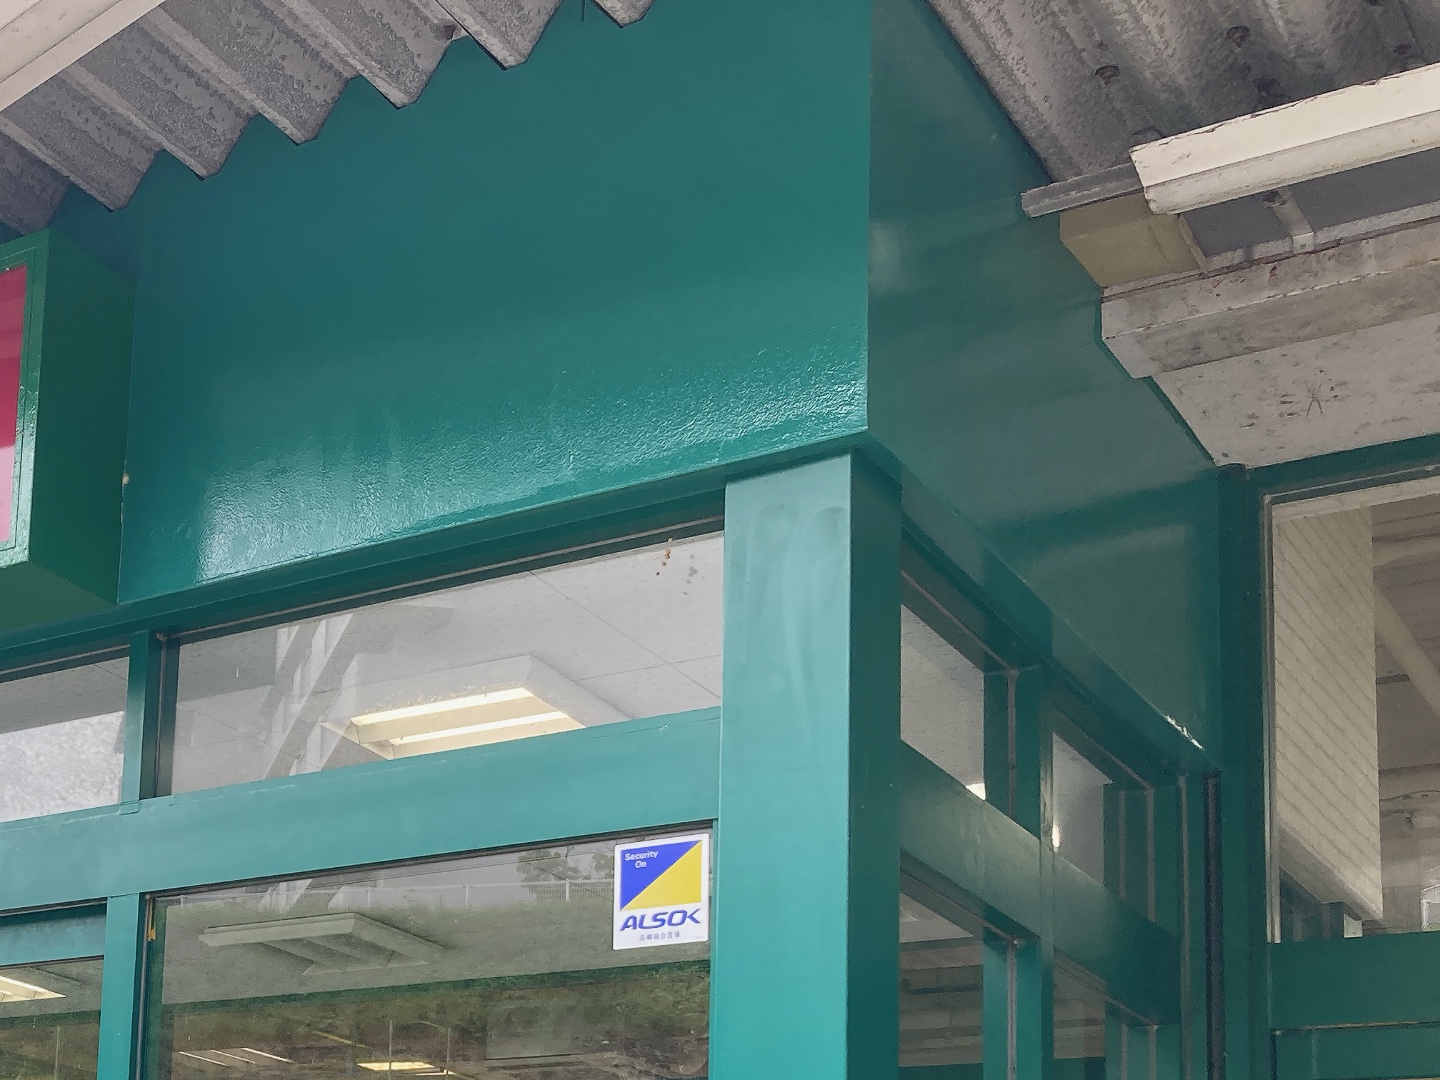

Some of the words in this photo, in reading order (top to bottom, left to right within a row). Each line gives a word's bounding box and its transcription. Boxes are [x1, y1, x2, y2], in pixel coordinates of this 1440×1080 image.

[624, 850, 659, 862] Security
[634, 860, 647, 869] On
[619, 908, 702, 932] ALSOK
